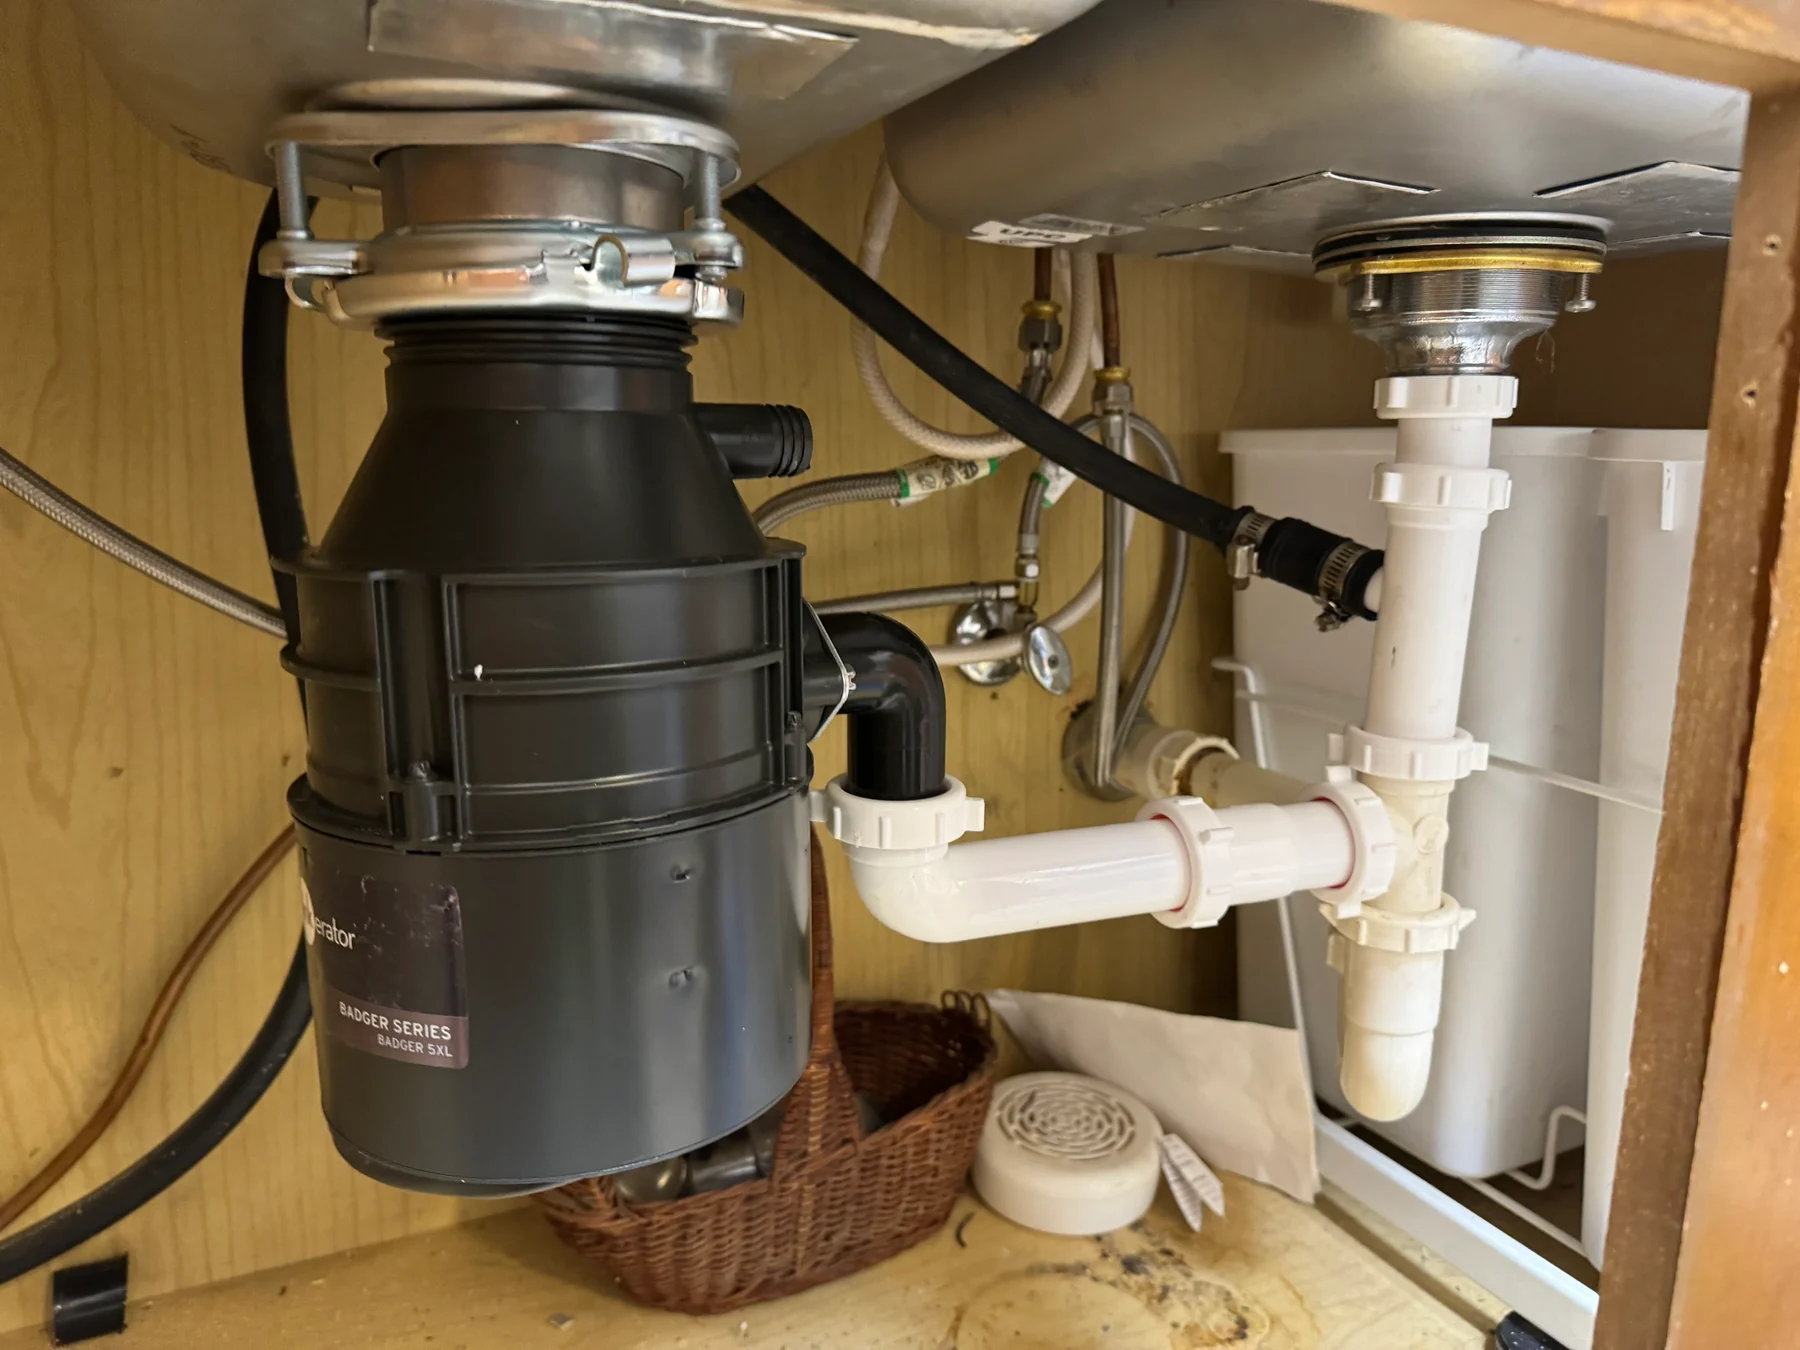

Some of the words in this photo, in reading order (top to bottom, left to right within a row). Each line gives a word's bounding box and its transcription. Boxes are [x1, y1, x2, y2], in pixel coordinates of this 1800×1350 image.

[339, 1001, 389, 1031] BADGER
[393, 1018, 452, 1040] SERIES
[377, 1033, 424, 1054] BADGER
[427, 1043, 453, 1057] 5XL
